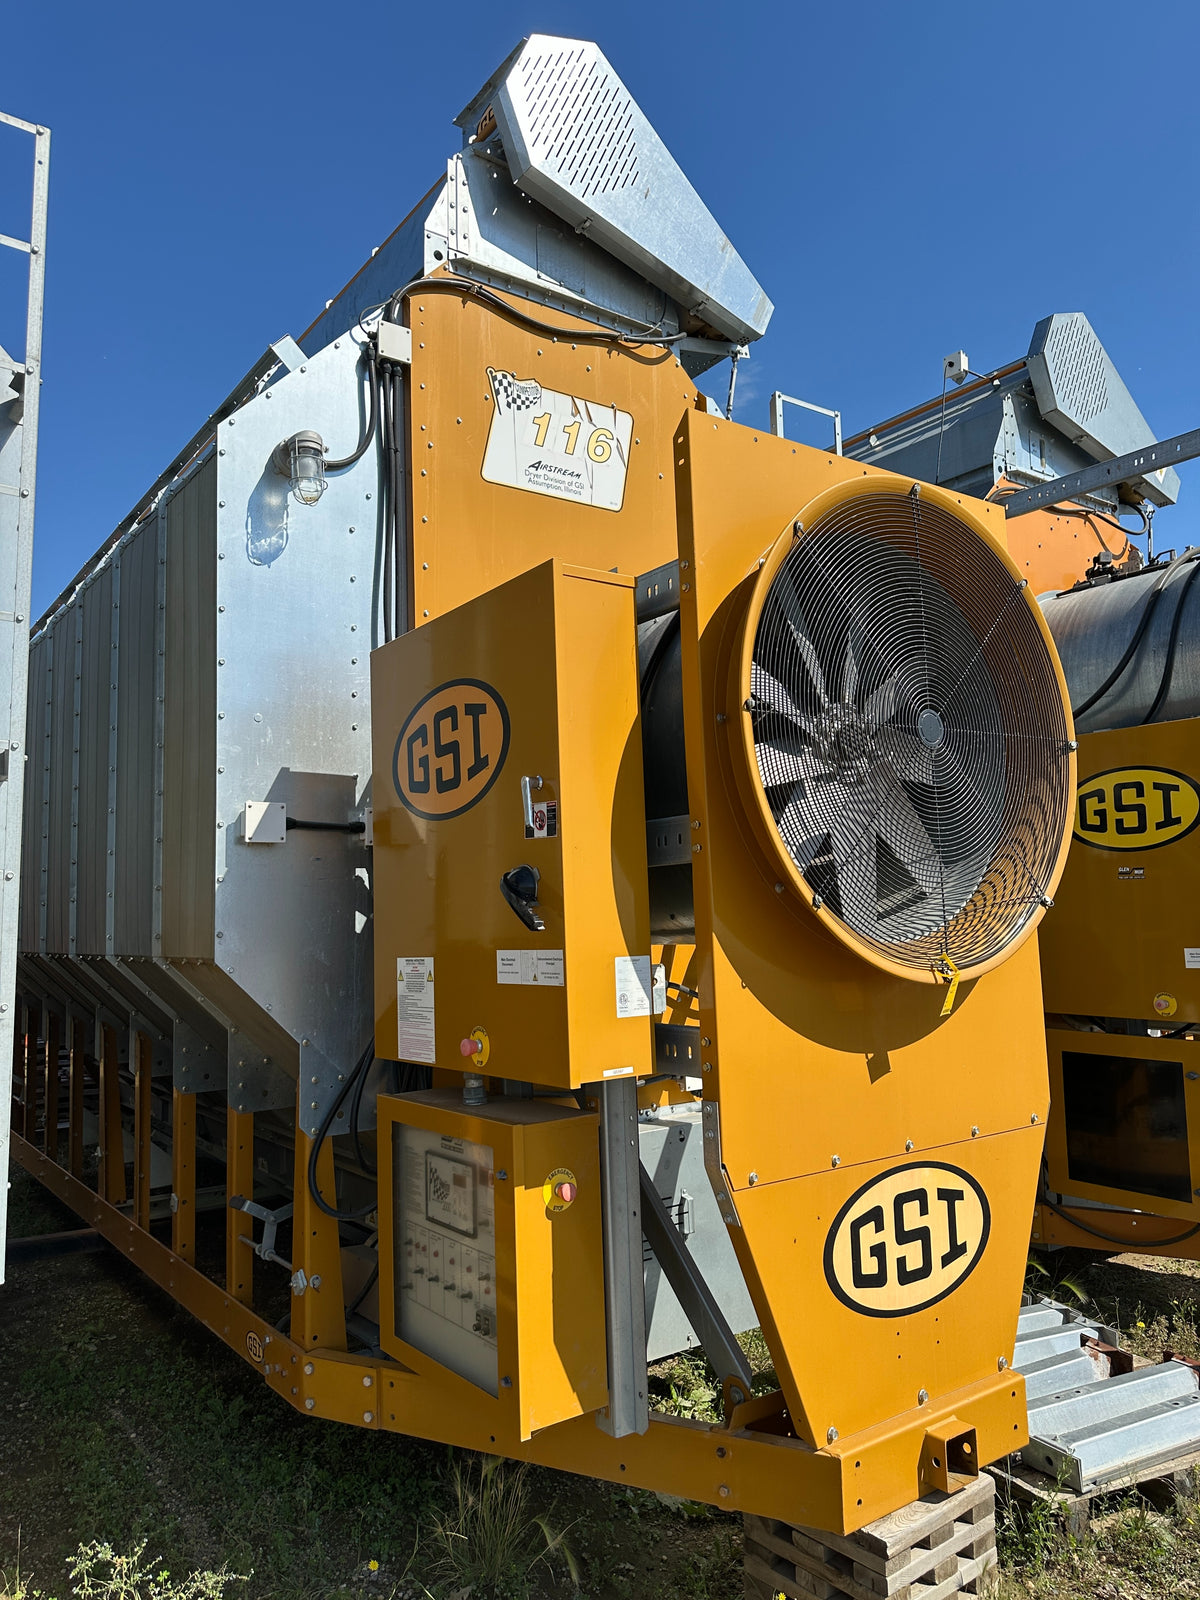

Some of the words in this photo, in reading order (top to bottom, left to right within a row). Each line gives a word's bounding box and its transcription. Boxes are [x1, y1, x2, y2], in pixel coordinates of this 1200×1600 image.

[532, 412, 615, 464] 116
[524, 469, 542, 480] Dryer
[543, 473, 566, 485] Division
[574, 481, 585, 490] GSI
[563, 486, 582, 496] Illinois
[406, 703, 490, 795] GSI
[1078, 780, 1182, 835] GSI
[548, 1168, 574, 1181] EMERGENCY
[850, 1187, 968, 1289] GSI
[248, 1335, 262, 1359] GSI
